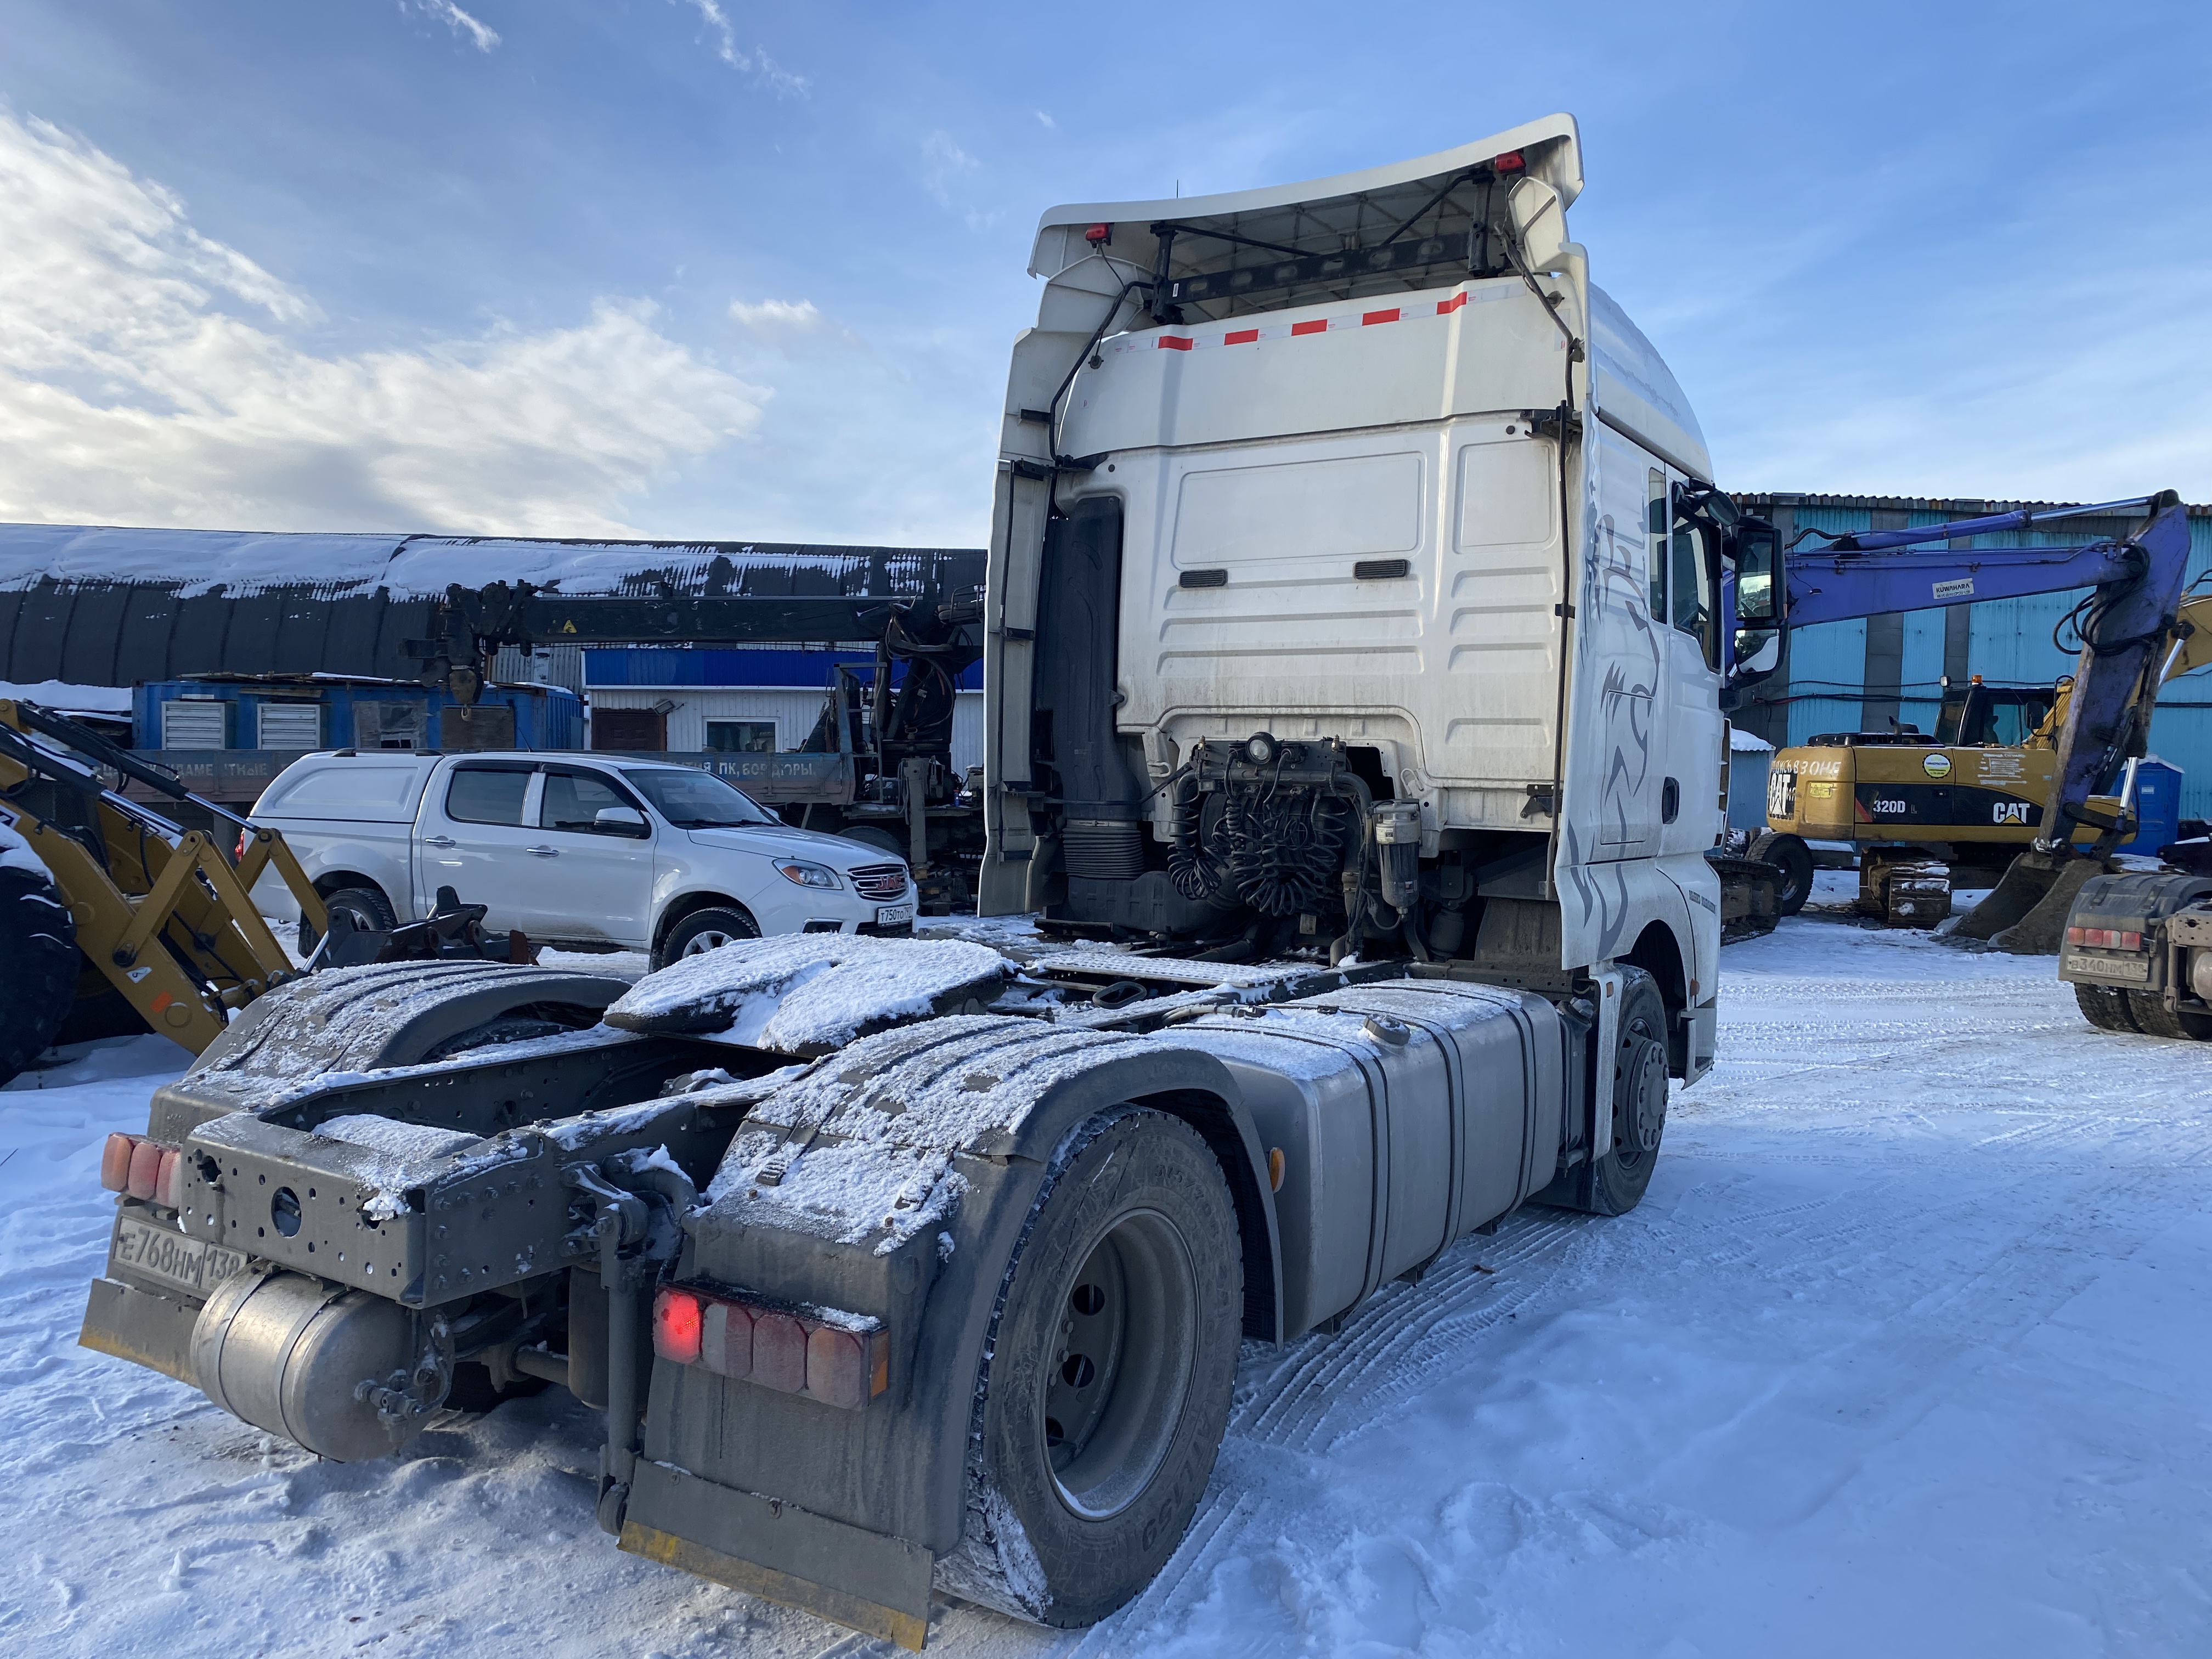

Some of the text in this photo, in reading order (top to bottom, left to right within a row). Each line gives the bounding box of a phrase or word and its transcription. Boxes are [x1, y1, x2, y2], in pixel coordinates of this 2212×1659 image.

[1936, 583, 1970, 593] KUWAHARA
[1873, 800, 1906, 813] 320D
[1993, 802, 2030, 823] CAT
[876, 875, 902, 890] JAC
